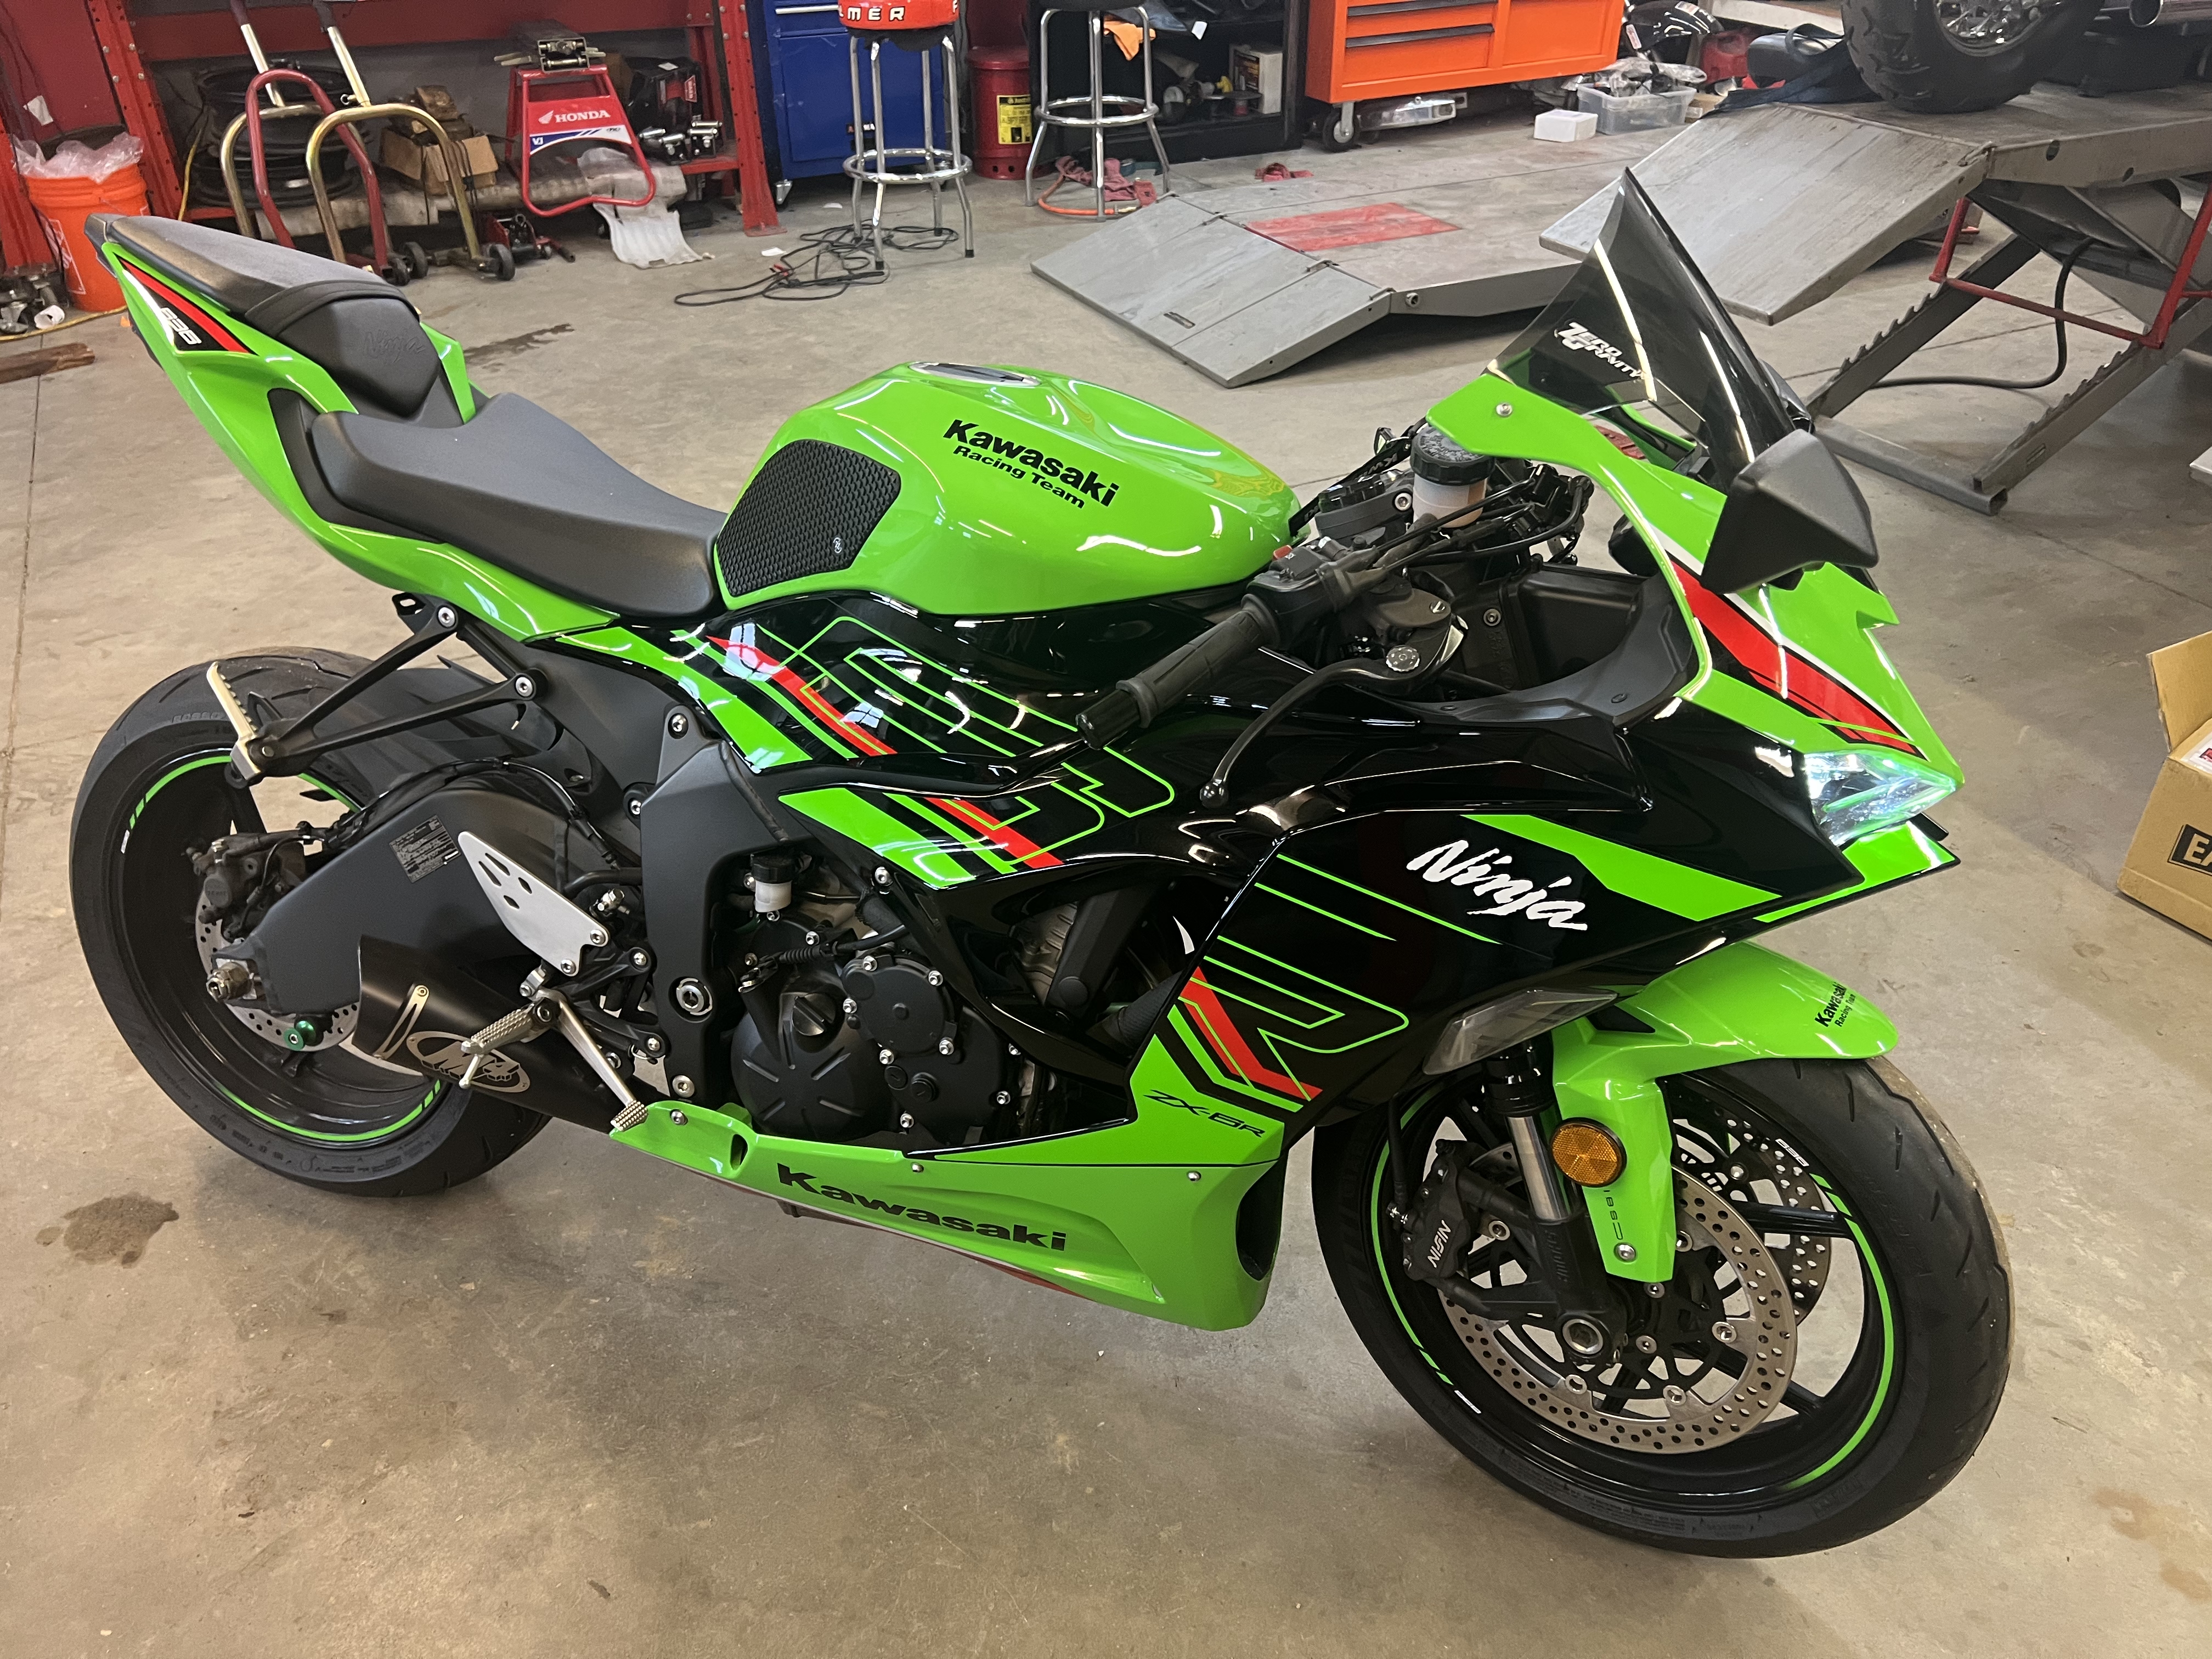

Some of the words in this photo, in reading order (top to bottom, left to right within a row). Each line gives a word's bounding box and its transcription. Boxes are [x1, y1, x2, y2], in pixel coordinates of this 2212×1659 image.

[555, 110, 611, 123] HONDA
[160, 307, 202, 345] 636
[943, 419, 1120, 507] Kawasaki
[953, 445, 1026, 479] Racing
[1031, 472, 1085, 509] Team
[1406, 839, 1588, 931] Ninja
[1814, 981, 1847, 1027] Kawasaki
[1834, 1005, 1853, 1027] Racing
[1143, 1089, 1266, 1138] ZX-6R
[777, 1163, 1066, 1251] Kawasaki
[1427, 1220, 1451, 1268] NISSIN
